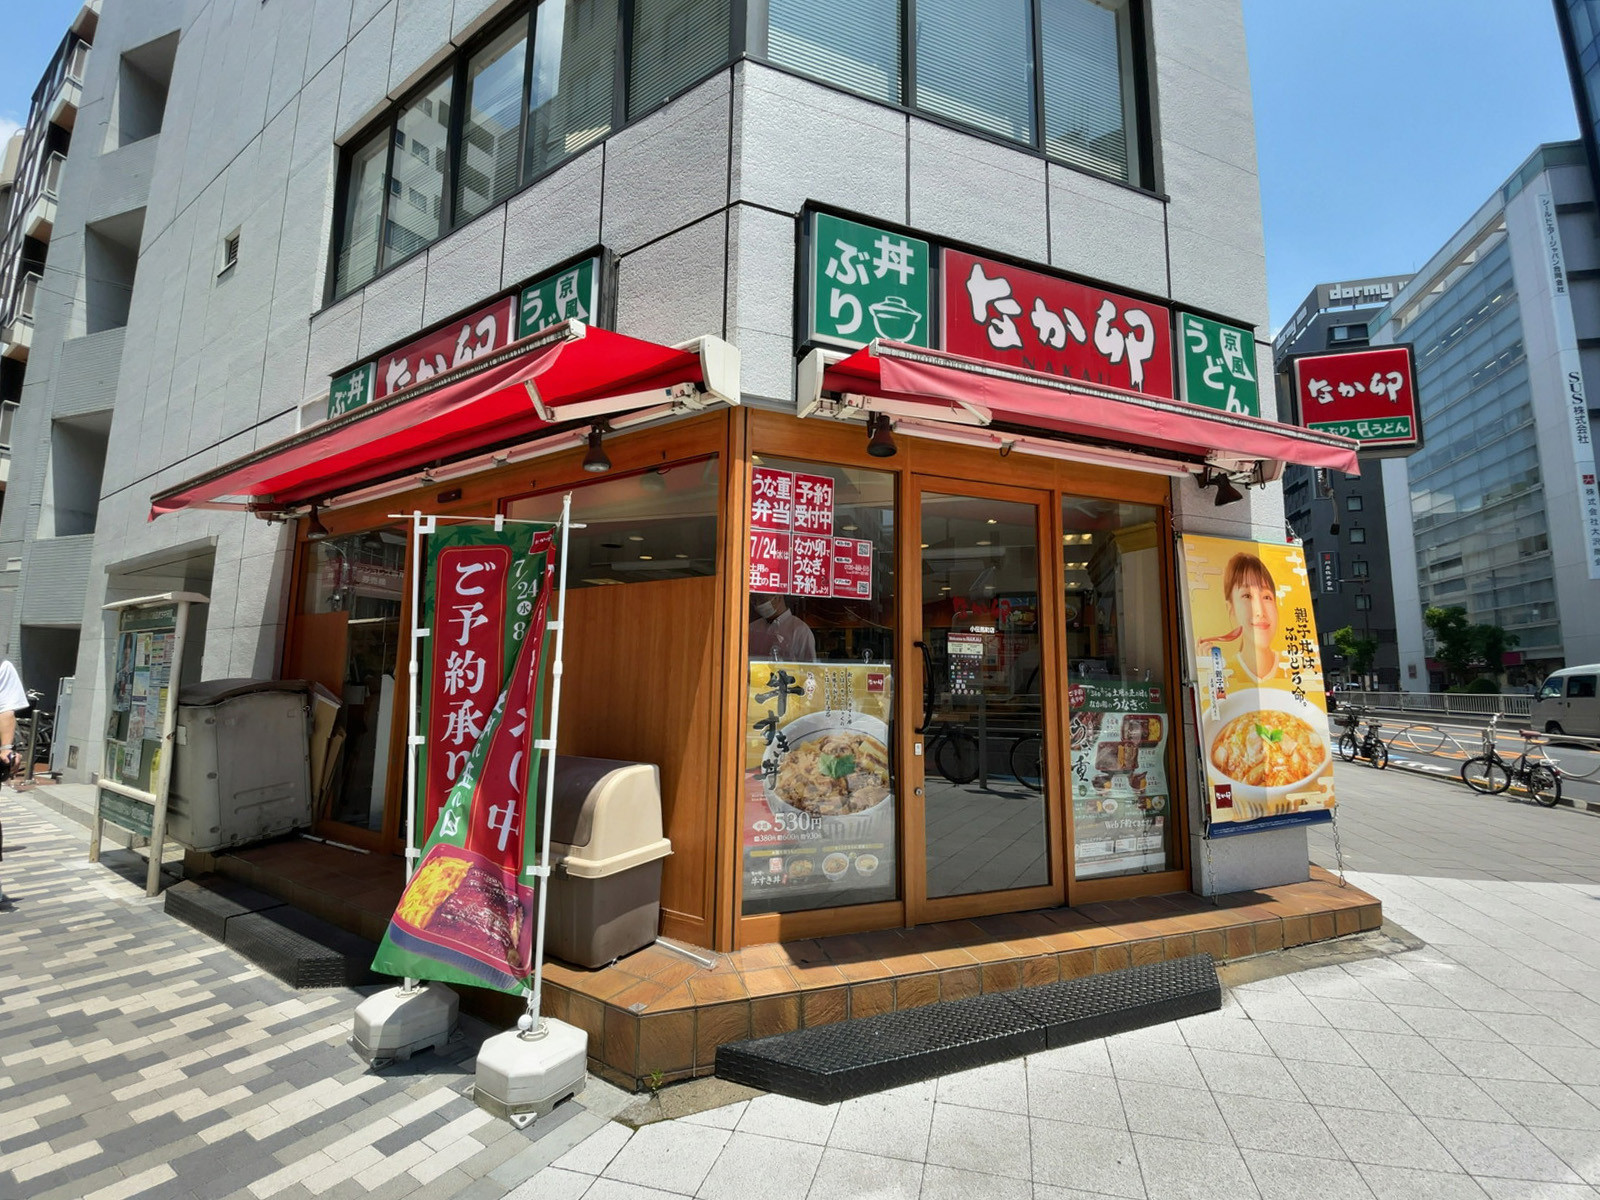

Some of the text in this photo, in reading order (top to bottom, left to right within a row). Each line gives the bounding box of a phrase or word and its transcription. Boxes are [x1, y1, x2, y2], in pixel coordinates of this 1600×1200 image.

[824, 238, 870, 334] ぶり
[1329, 283, 1395, 300] dormy
[965, 262, 1156, 390] なか卯
[1222, 332, 1247, 376] 京風
[1308, 370, 1404, 404] なか卯
[753, 474, 791, 499] うな重
[796, 481, 832, 506] 予約
[752, 499, 790, 524] 弁当
[795, 505, 832, 530] 受付中
[440, 562, 496, 798] ご予約承り
[774, 811, 822, 831] 530円
